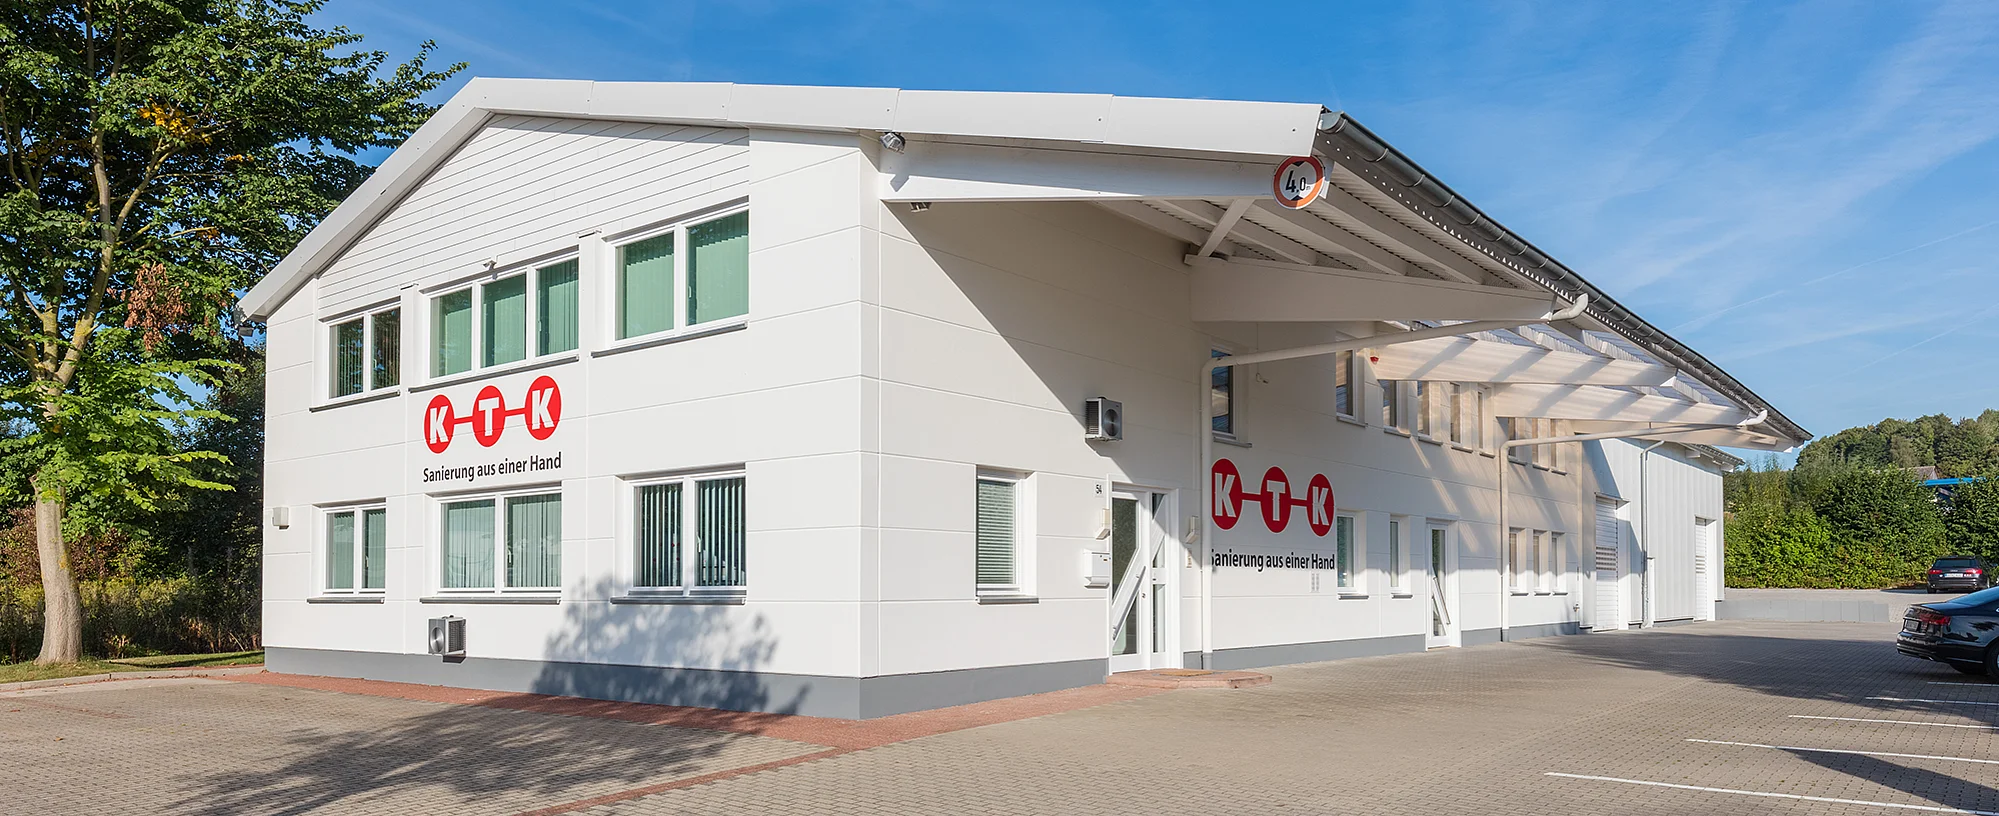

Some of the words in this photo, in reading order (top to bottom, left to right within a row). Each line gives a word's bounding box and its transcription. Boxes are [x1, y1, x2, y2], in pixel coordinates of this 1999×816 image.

[423, 465, 475, 482] Sanierung
[477, 463, 496, 477] aus
[498, 458, 528, 475] einer
[530, 451, 562, 472] Hand
[1266, 554, 1284, 569] aus
[1286, 552, 1310, 570] einer
[1311, 553, 1335, 570] Hand
